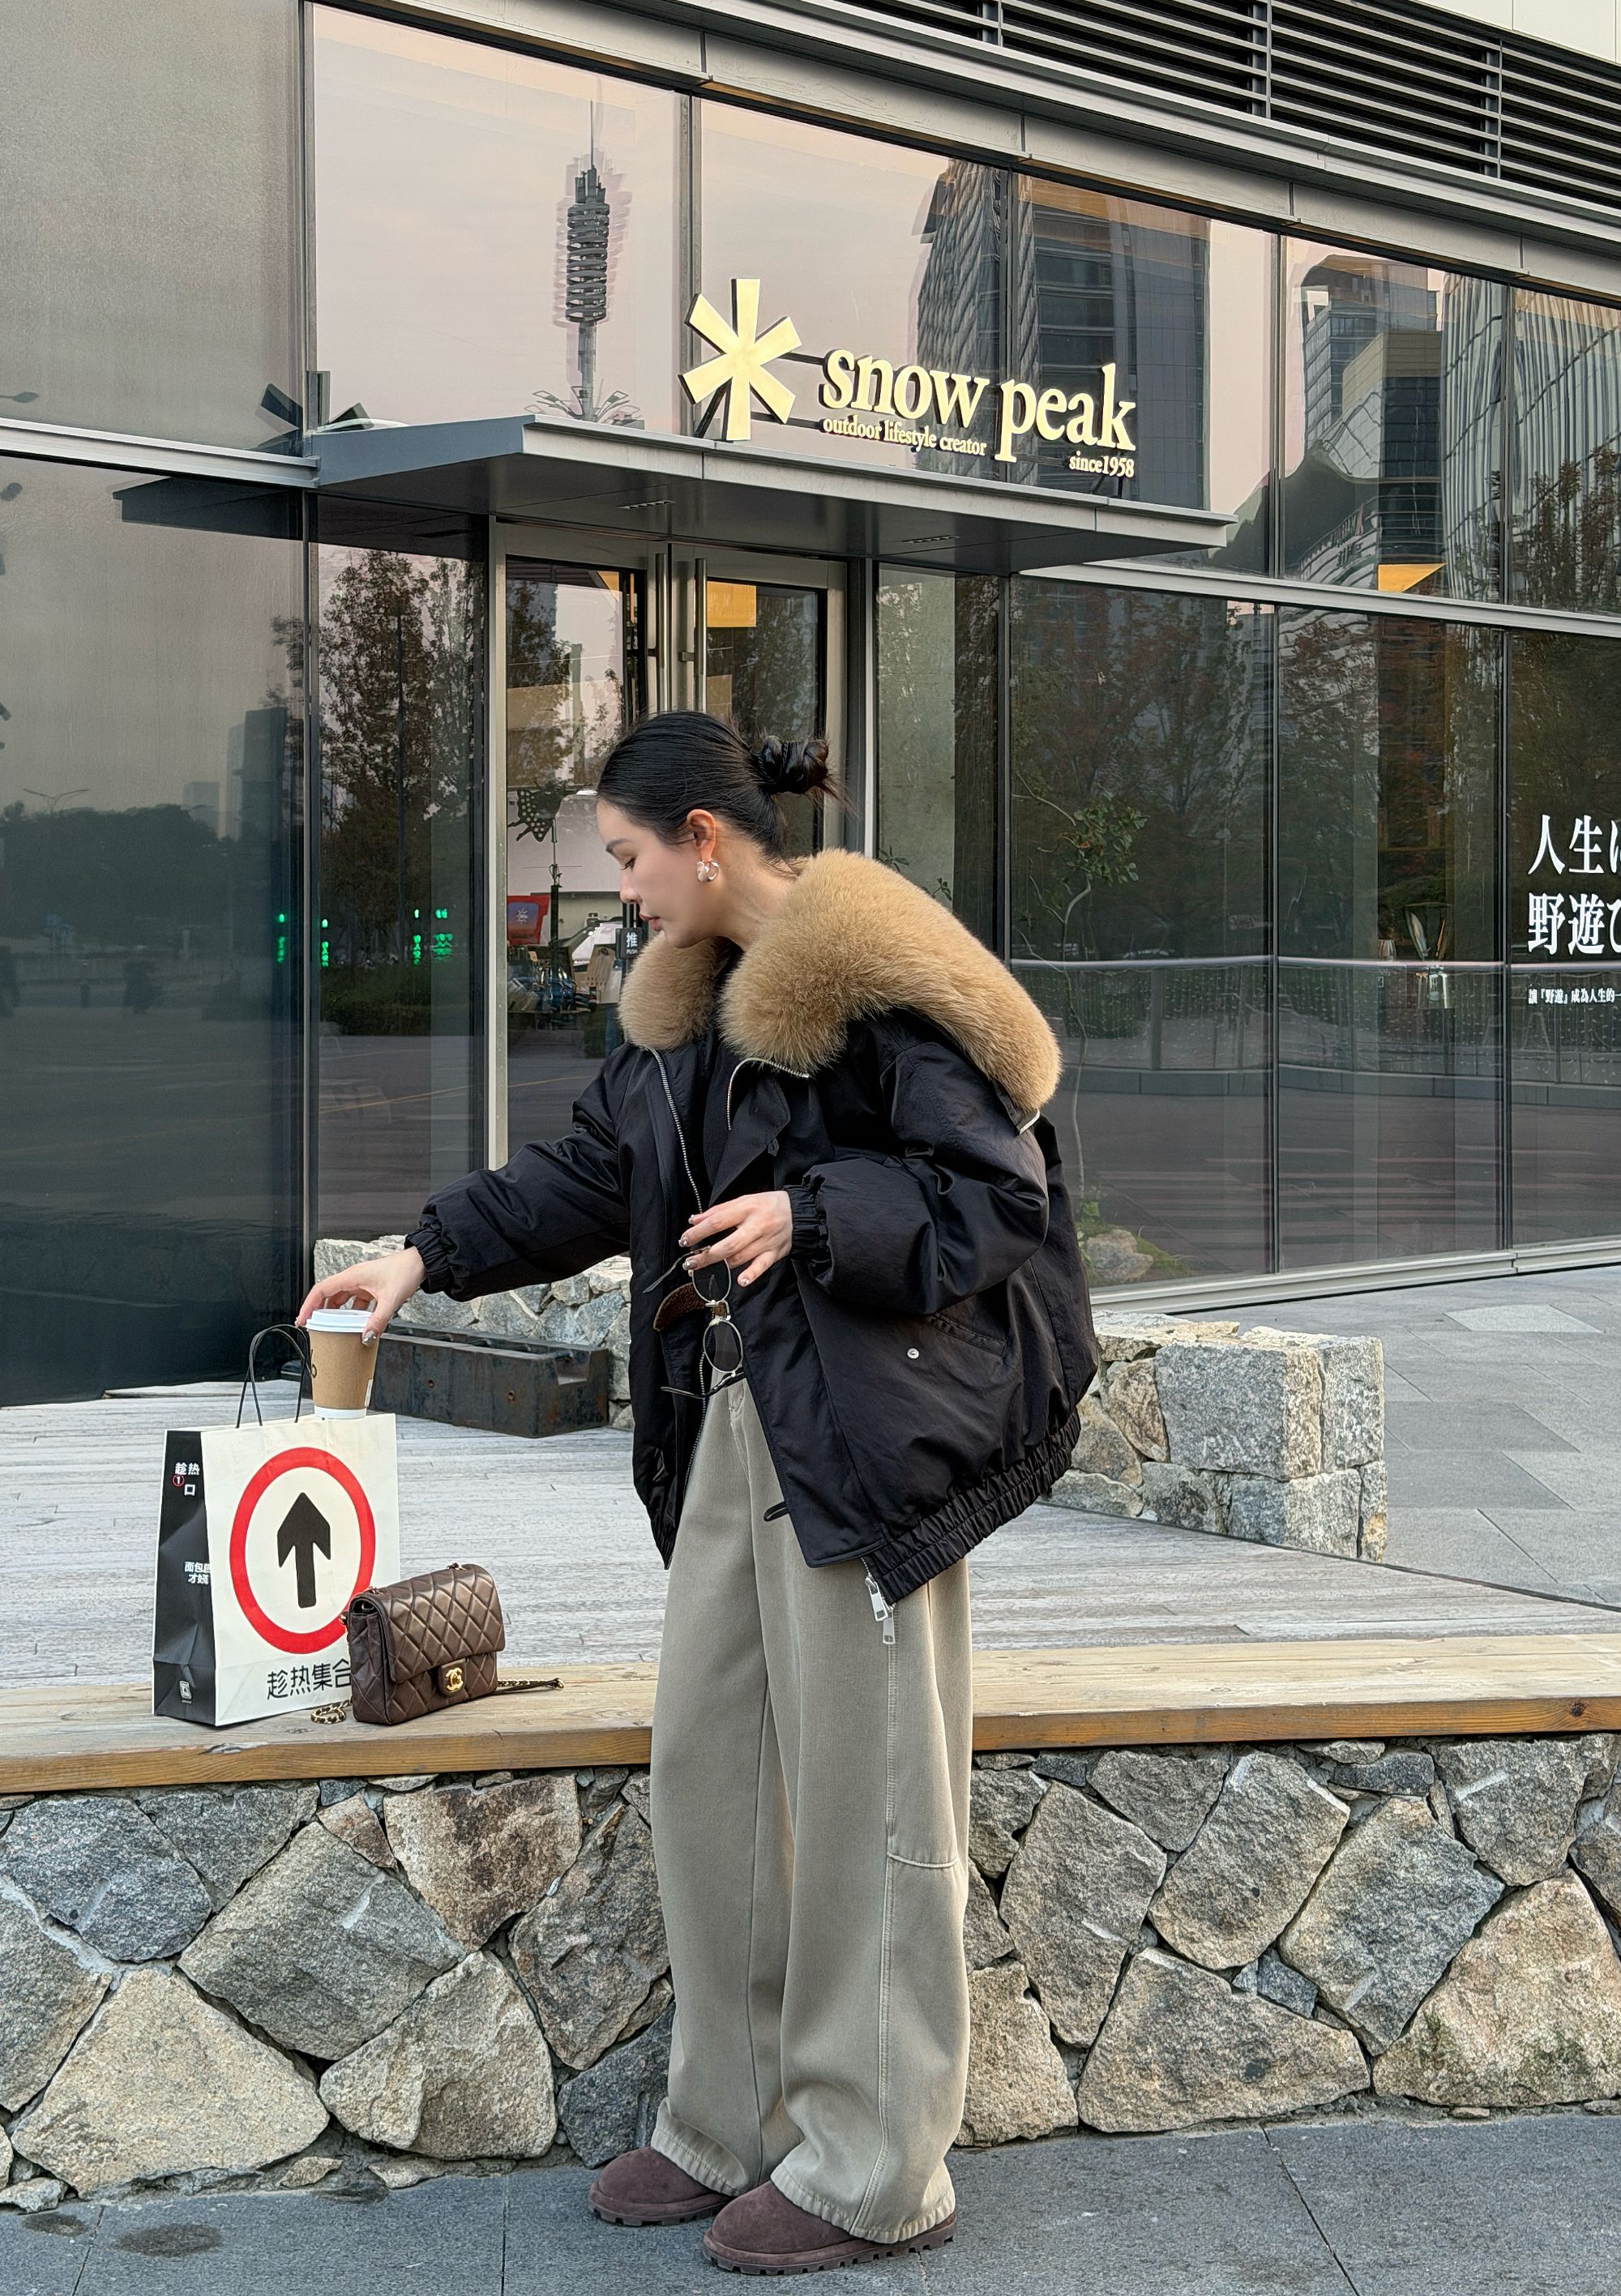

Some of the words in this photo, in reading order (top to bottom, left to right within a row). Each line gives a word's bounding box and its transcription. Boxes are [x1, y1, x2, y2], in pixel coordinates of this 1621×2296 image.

[822, 349, 990, 428] snow
[994, 362, 1136, 463] peak
[823, 414, 882, 440] outdoor
[883, 419, 937, 451] lifestyle
[939, 435, 987, 455] creator
[1069, 451, 1135, 477] since1958
[626, 932, 638, 947] 推
[174, 1461, 200, 1476] 趁热
[267, 1658, 352, 1700] 趁热集合
